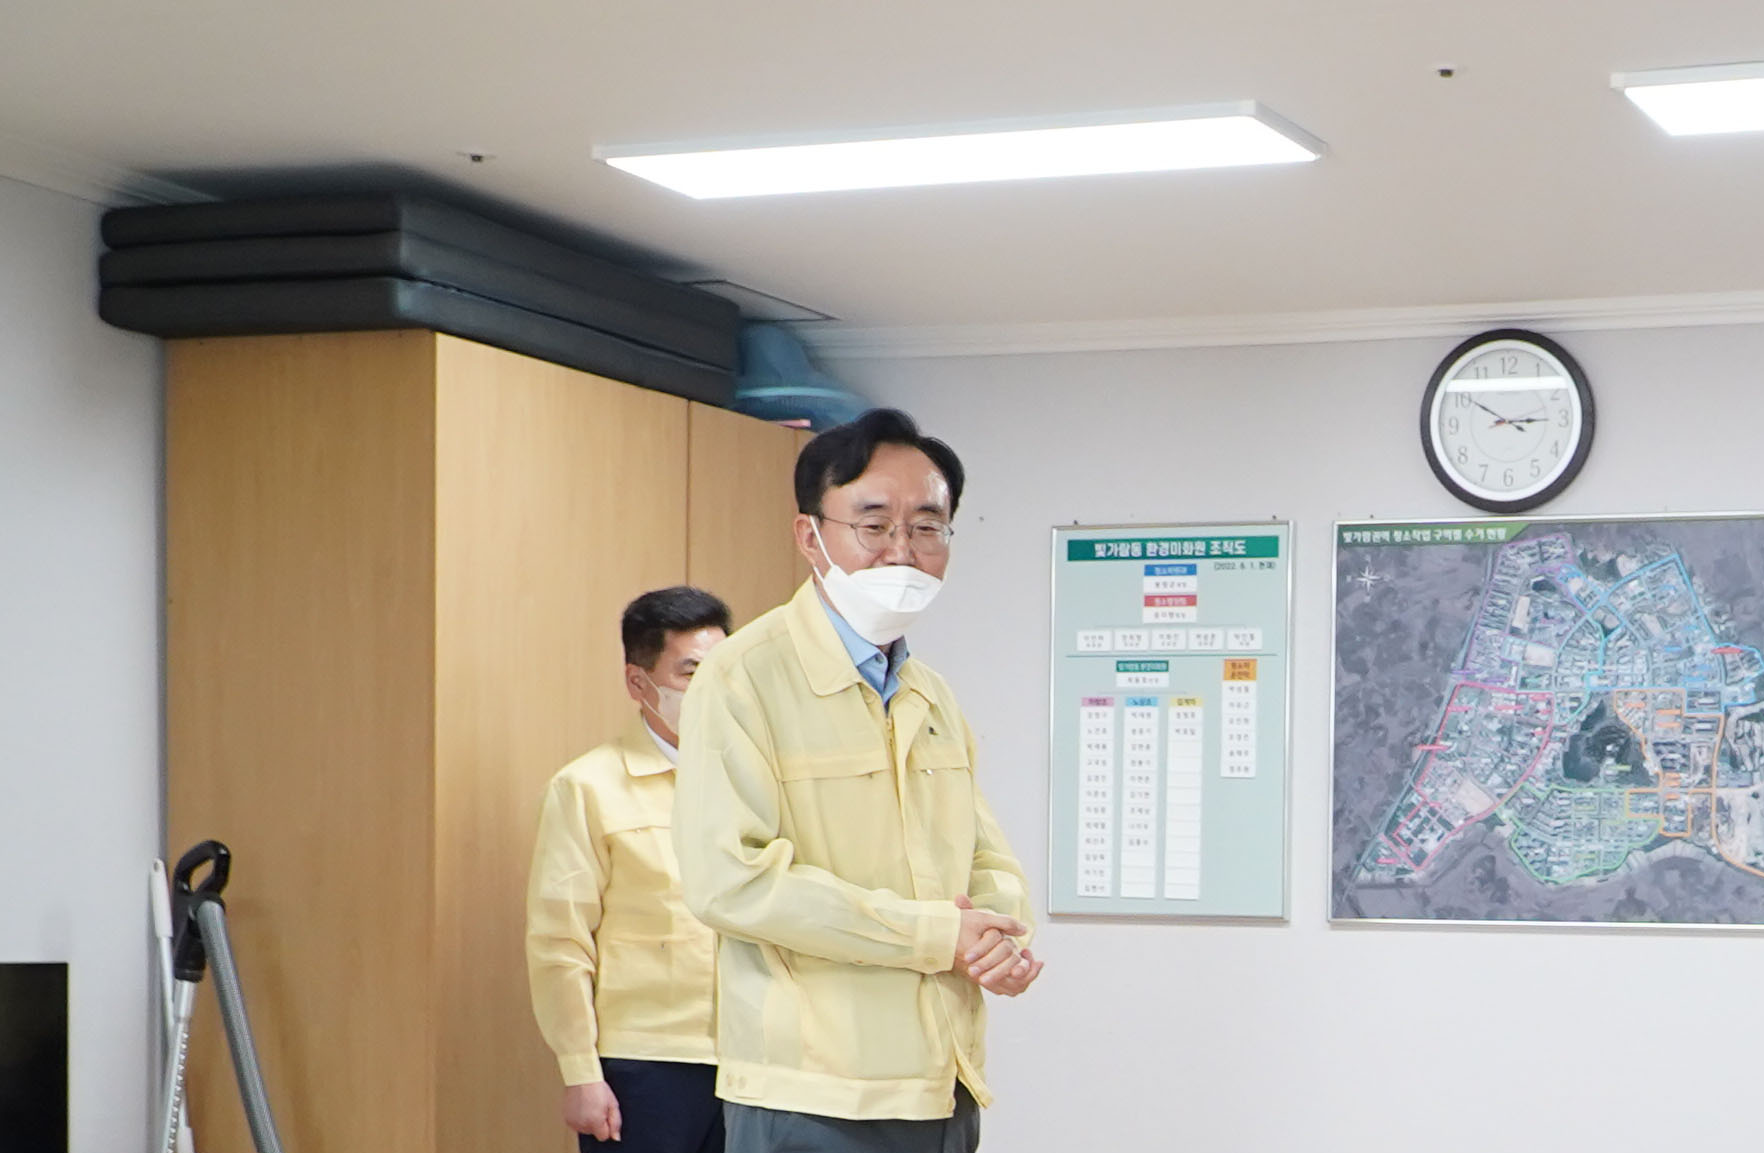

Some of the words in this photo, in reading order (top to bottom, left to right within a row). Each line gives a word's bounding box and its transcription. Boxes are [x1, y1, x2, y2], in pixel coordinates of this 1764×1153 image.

[1474, 366, 1488, 379] 11
[1500, 357, 1518, 375] 12
[1454, 391, 1472, 408] 10
[1448, 418, 1459, 435] 9
[1558, 410, 1569, 427] 3
[1457, 447, 1468, 465] 8
[1550, 440, 1559, 458] 4
[1479, 464, 1489, 482] 7
[1529, 459, 1541, 477] 5
[1503, 468, 1514, 487] 6
[1094, 542, 1142, 557] 빛가람동
[1146, 541, 1206, 556] 환경미화원
[1210, 540, 1246, 555] 조직도
